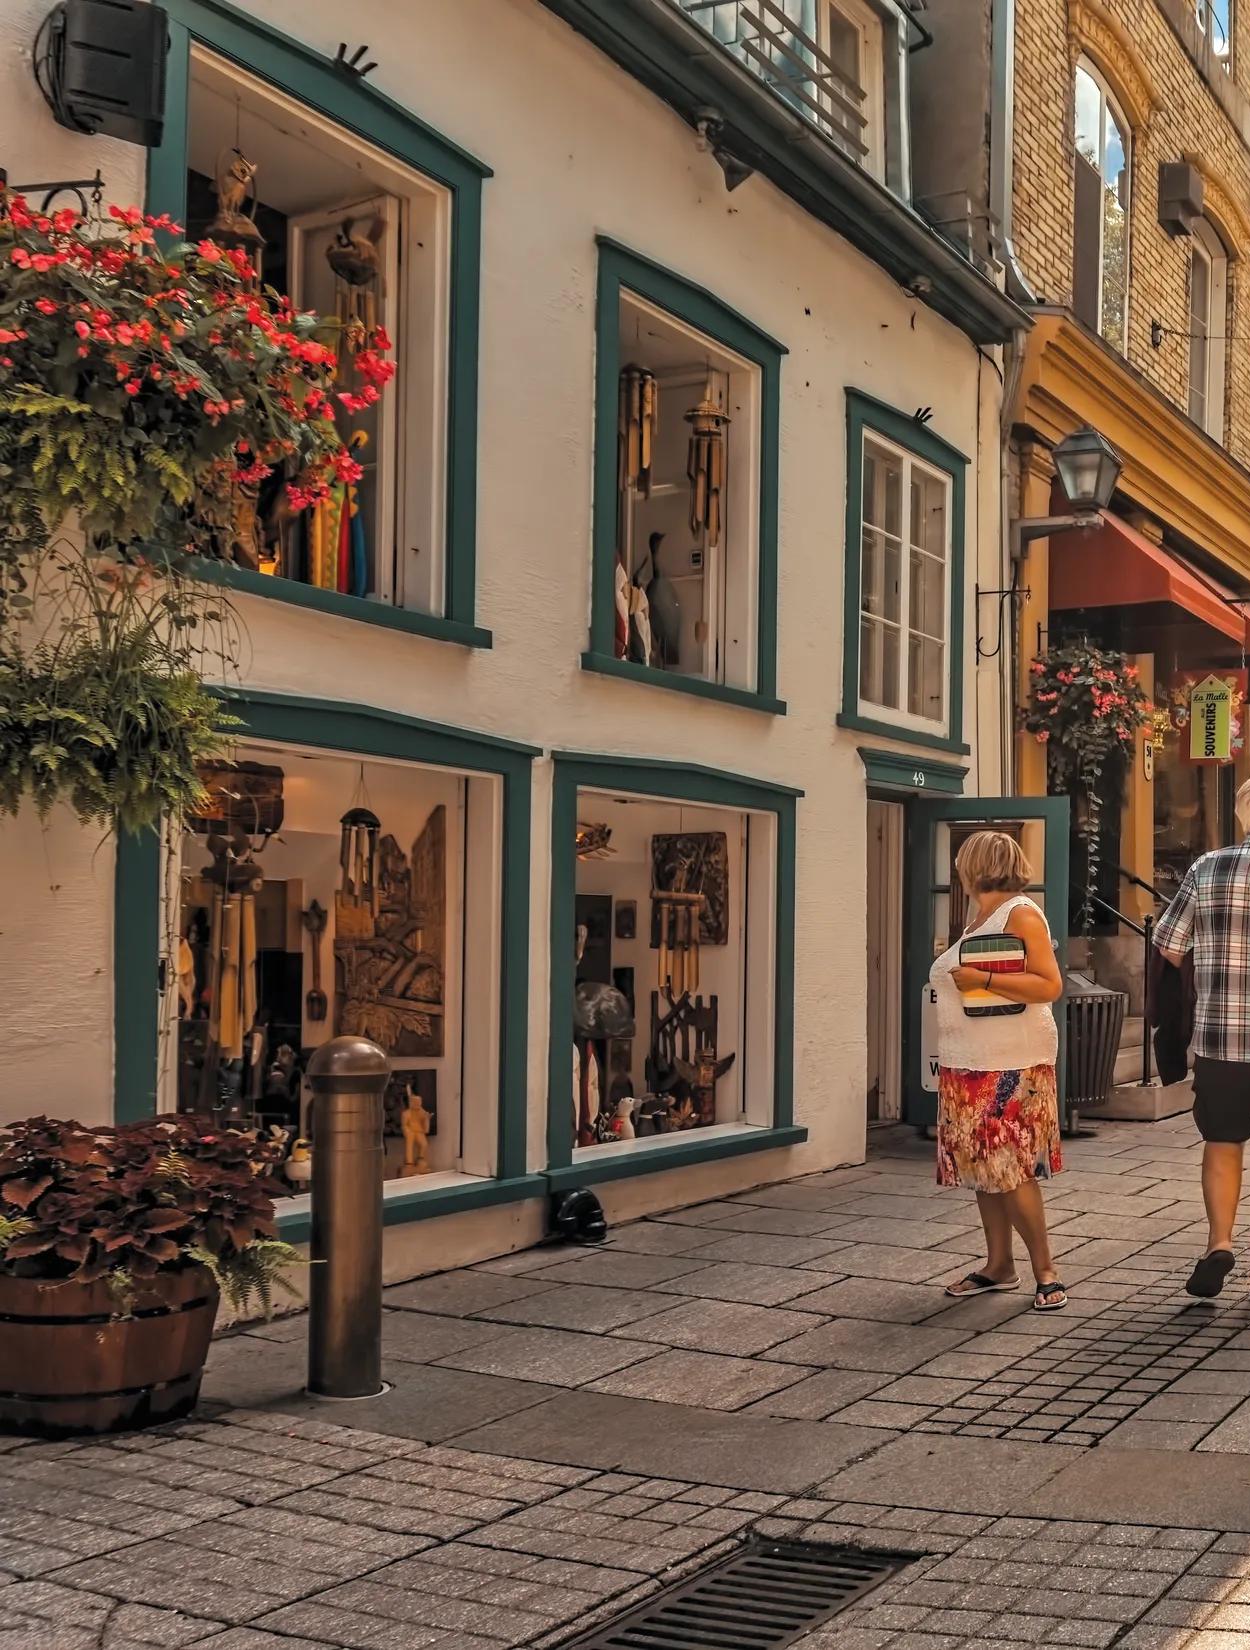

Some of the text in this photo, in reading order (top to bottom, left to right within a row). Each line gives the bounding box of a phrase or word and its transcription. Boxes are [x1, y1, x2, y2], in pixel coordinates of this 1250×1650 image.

[1205, 692, 1229, 701] Malle
[1204, 702, 1217, 757] SOUVENIRS
[912, 771, 925, 786] 49
